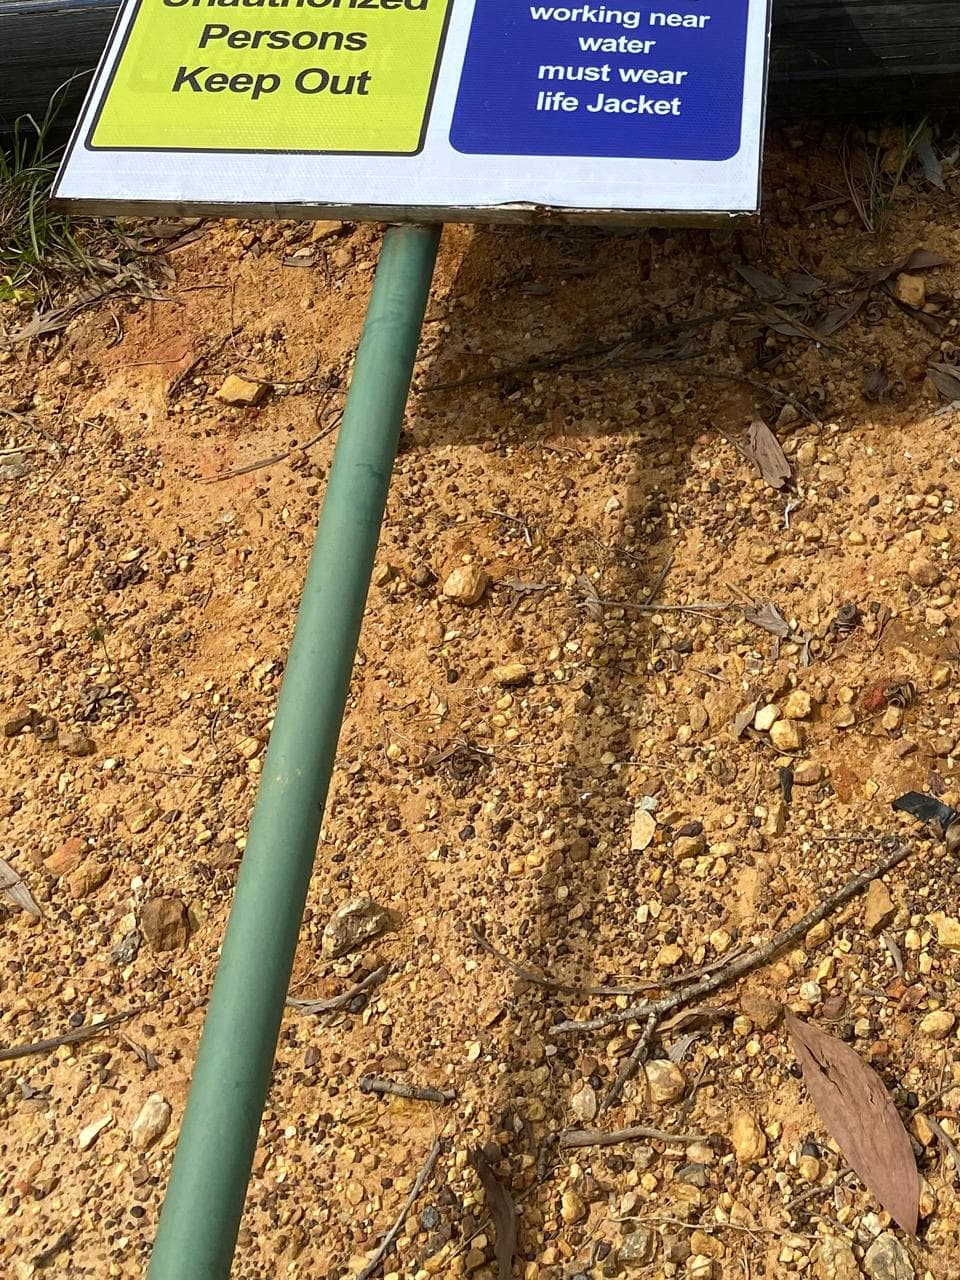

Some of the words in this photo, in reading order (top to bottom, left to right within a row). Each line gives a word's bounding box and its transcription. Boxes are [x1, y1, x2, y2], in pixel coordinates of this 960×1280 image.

[529, 4, 641, 29] working
[649, 12, 711, 28] near
[198, 23, 368, 51] Persons
[578, 35, 657, 54] water
[171, 66, 281, 100] Keep
[294, 67, 372, 96] Out
[537, 63, 612, 82] must
[618, 68, 688, 85] wear
[536, 91, 579, 112] life
[586, 93, 682, 116] Jacket
